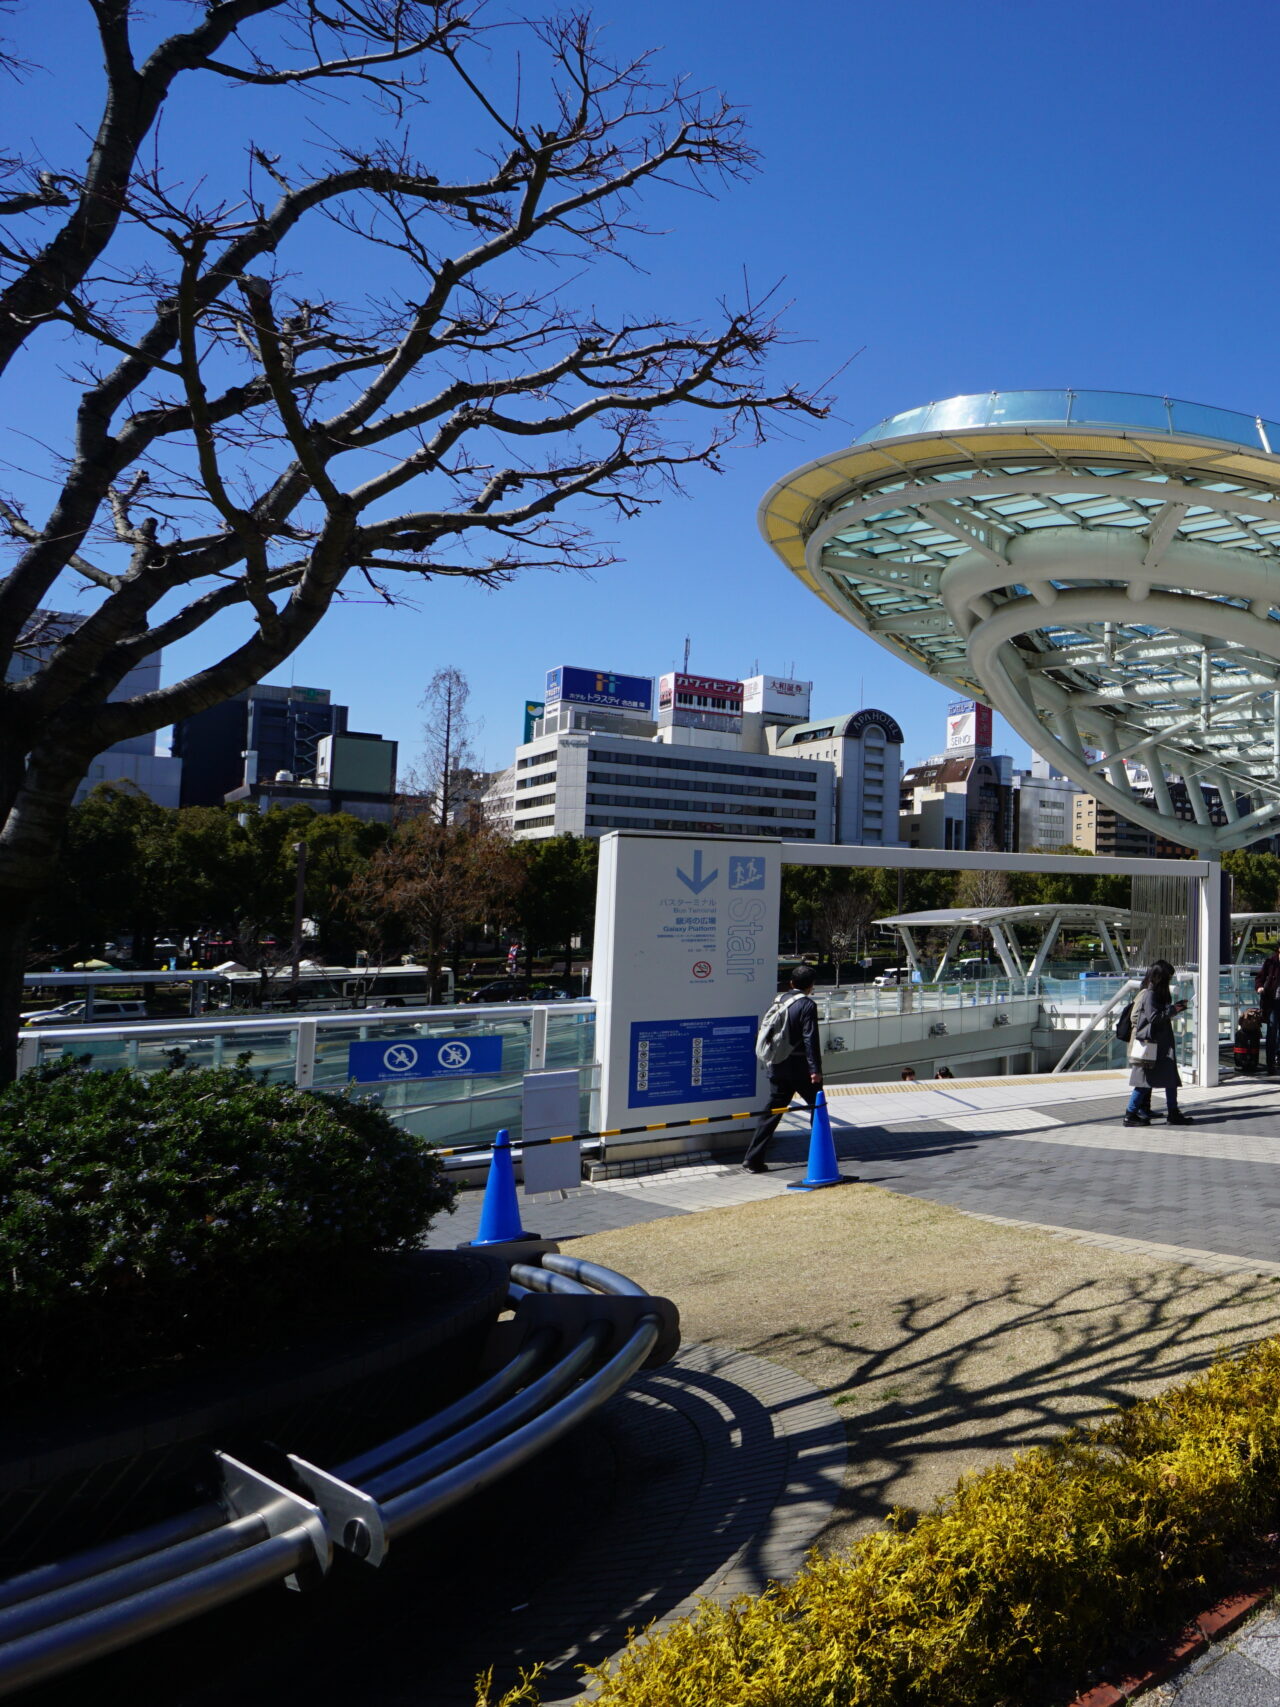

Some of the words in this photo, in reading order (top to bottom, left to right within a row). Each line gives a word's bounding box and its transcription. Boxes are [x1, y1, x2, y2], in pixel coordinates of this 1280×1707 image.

[676, 676, 743, 694] カワイピアノ
[770, 680, 803, 694] 大和証券
[587, 693, 620, 705] トラスティ
[871, 713, 900, 735] HOTEL
[951, 735, 971, 747] SEINO
[726, 897, 766, 982] Stair
